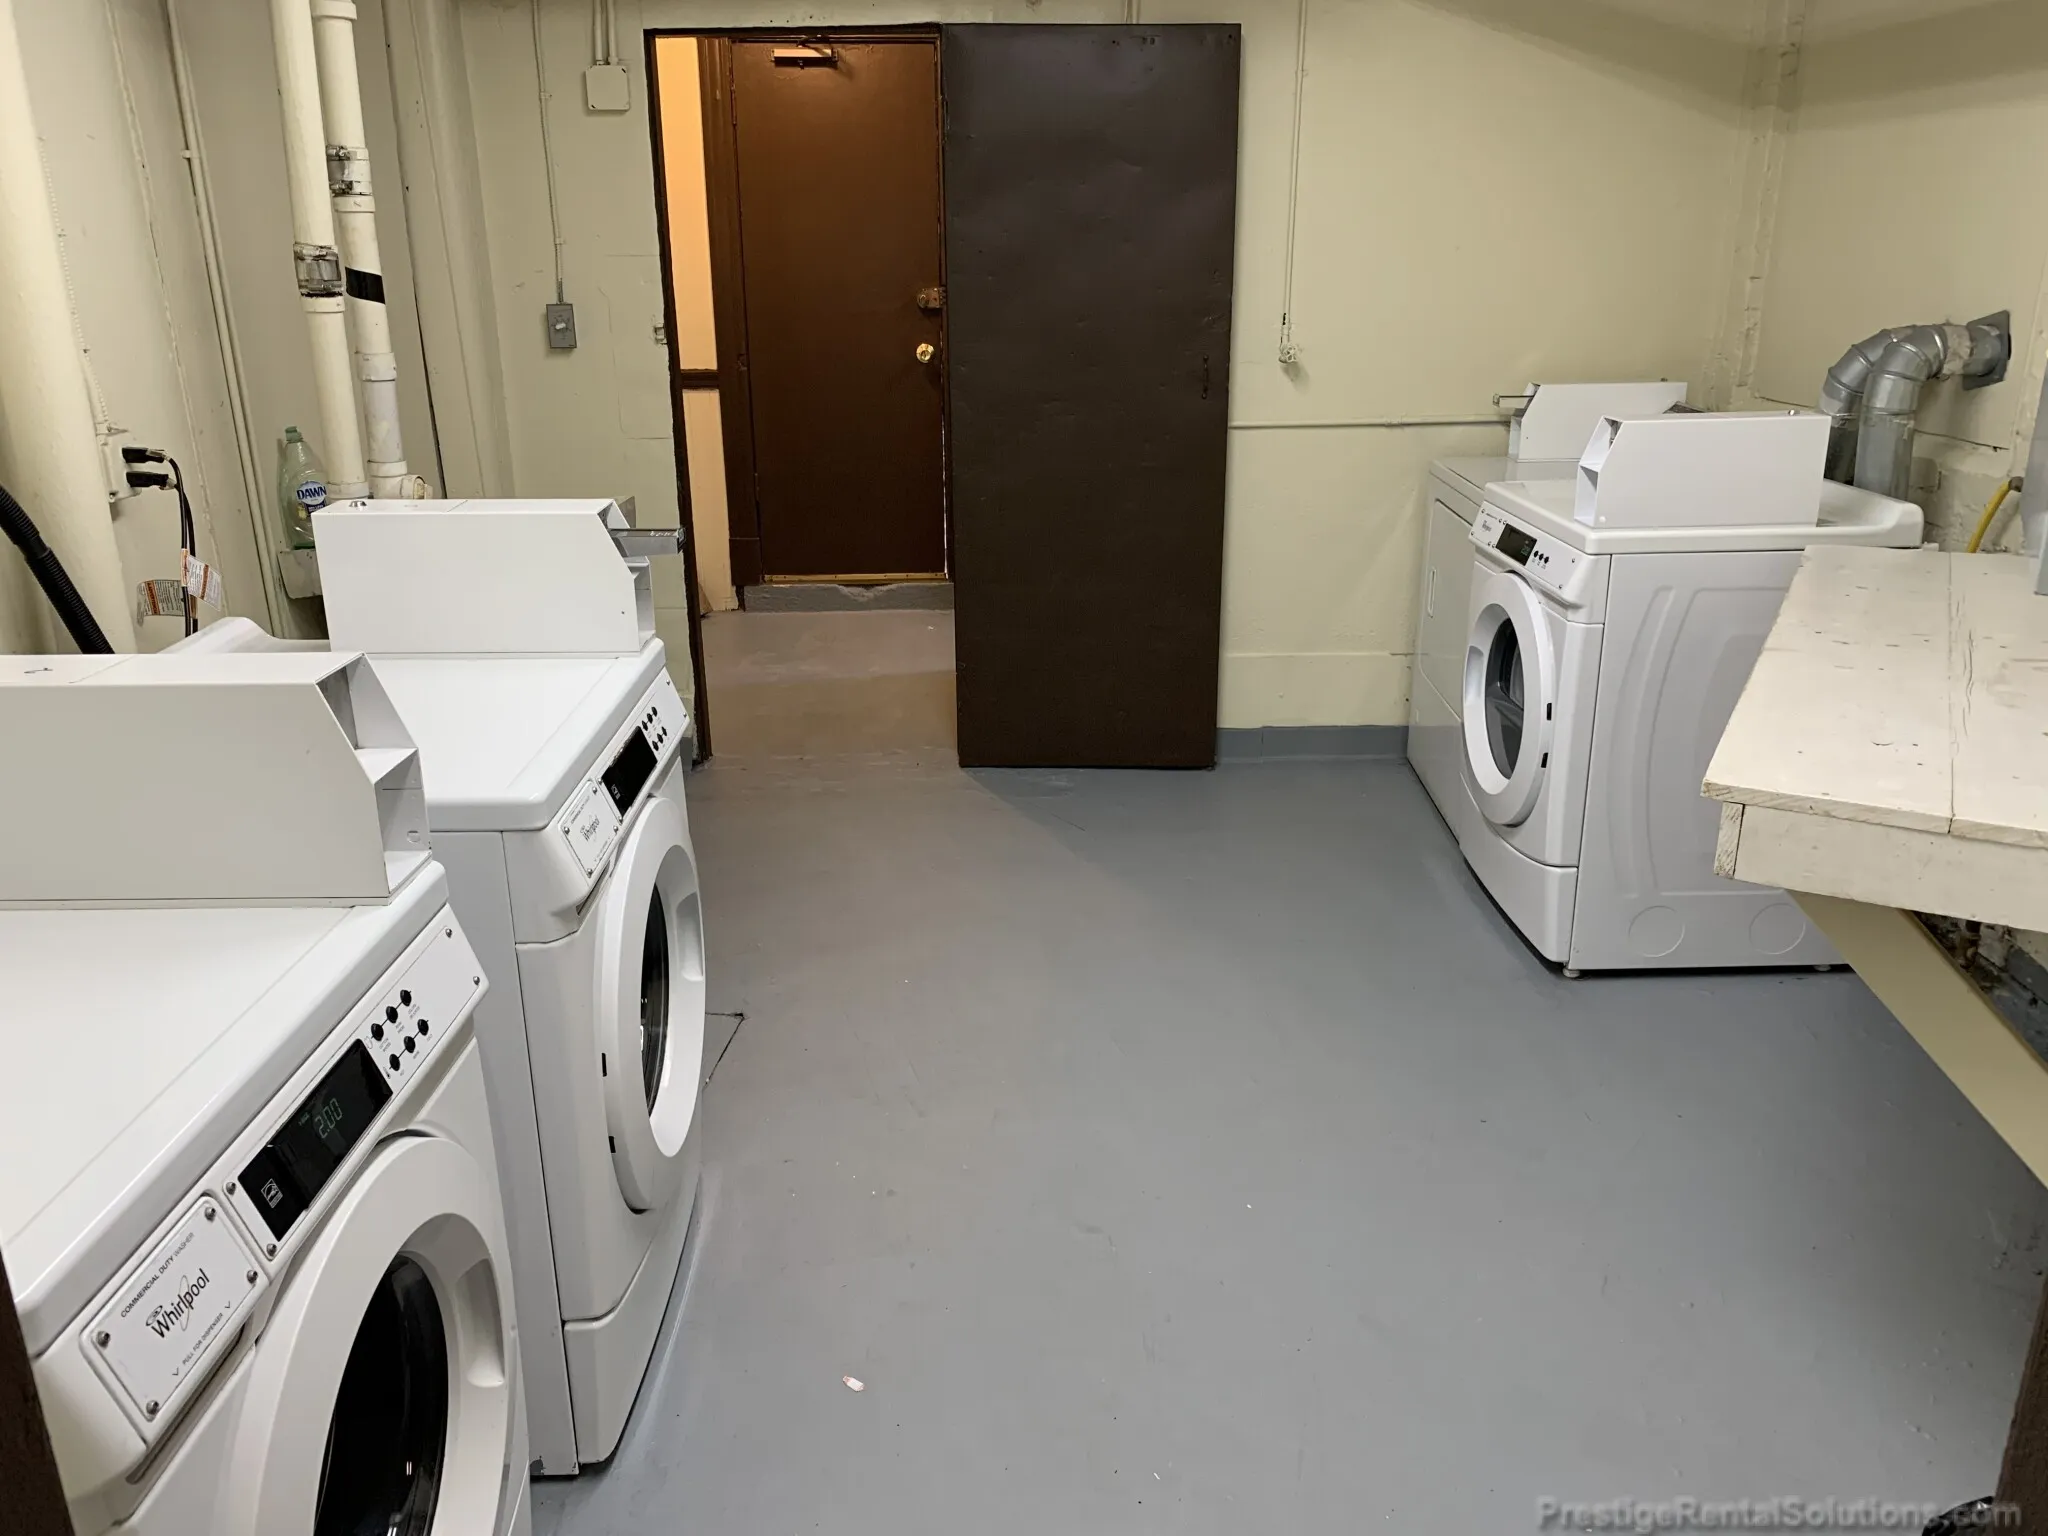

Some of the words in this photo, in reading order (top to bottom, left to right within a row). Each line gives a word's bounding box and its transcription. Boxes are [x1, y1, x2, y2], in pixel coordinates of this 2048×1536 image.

[296, 486, 327, 500] DAWN
[314, 1097, 343, 1139] 2.00
[120, 1274, 160, 1319] COMMERCIAL
[158, 1256, 175, 1275] DUTY
[173, 1232, 195, 1257] WASHER
[150, 1268, 211, 1339] Whirlpool
